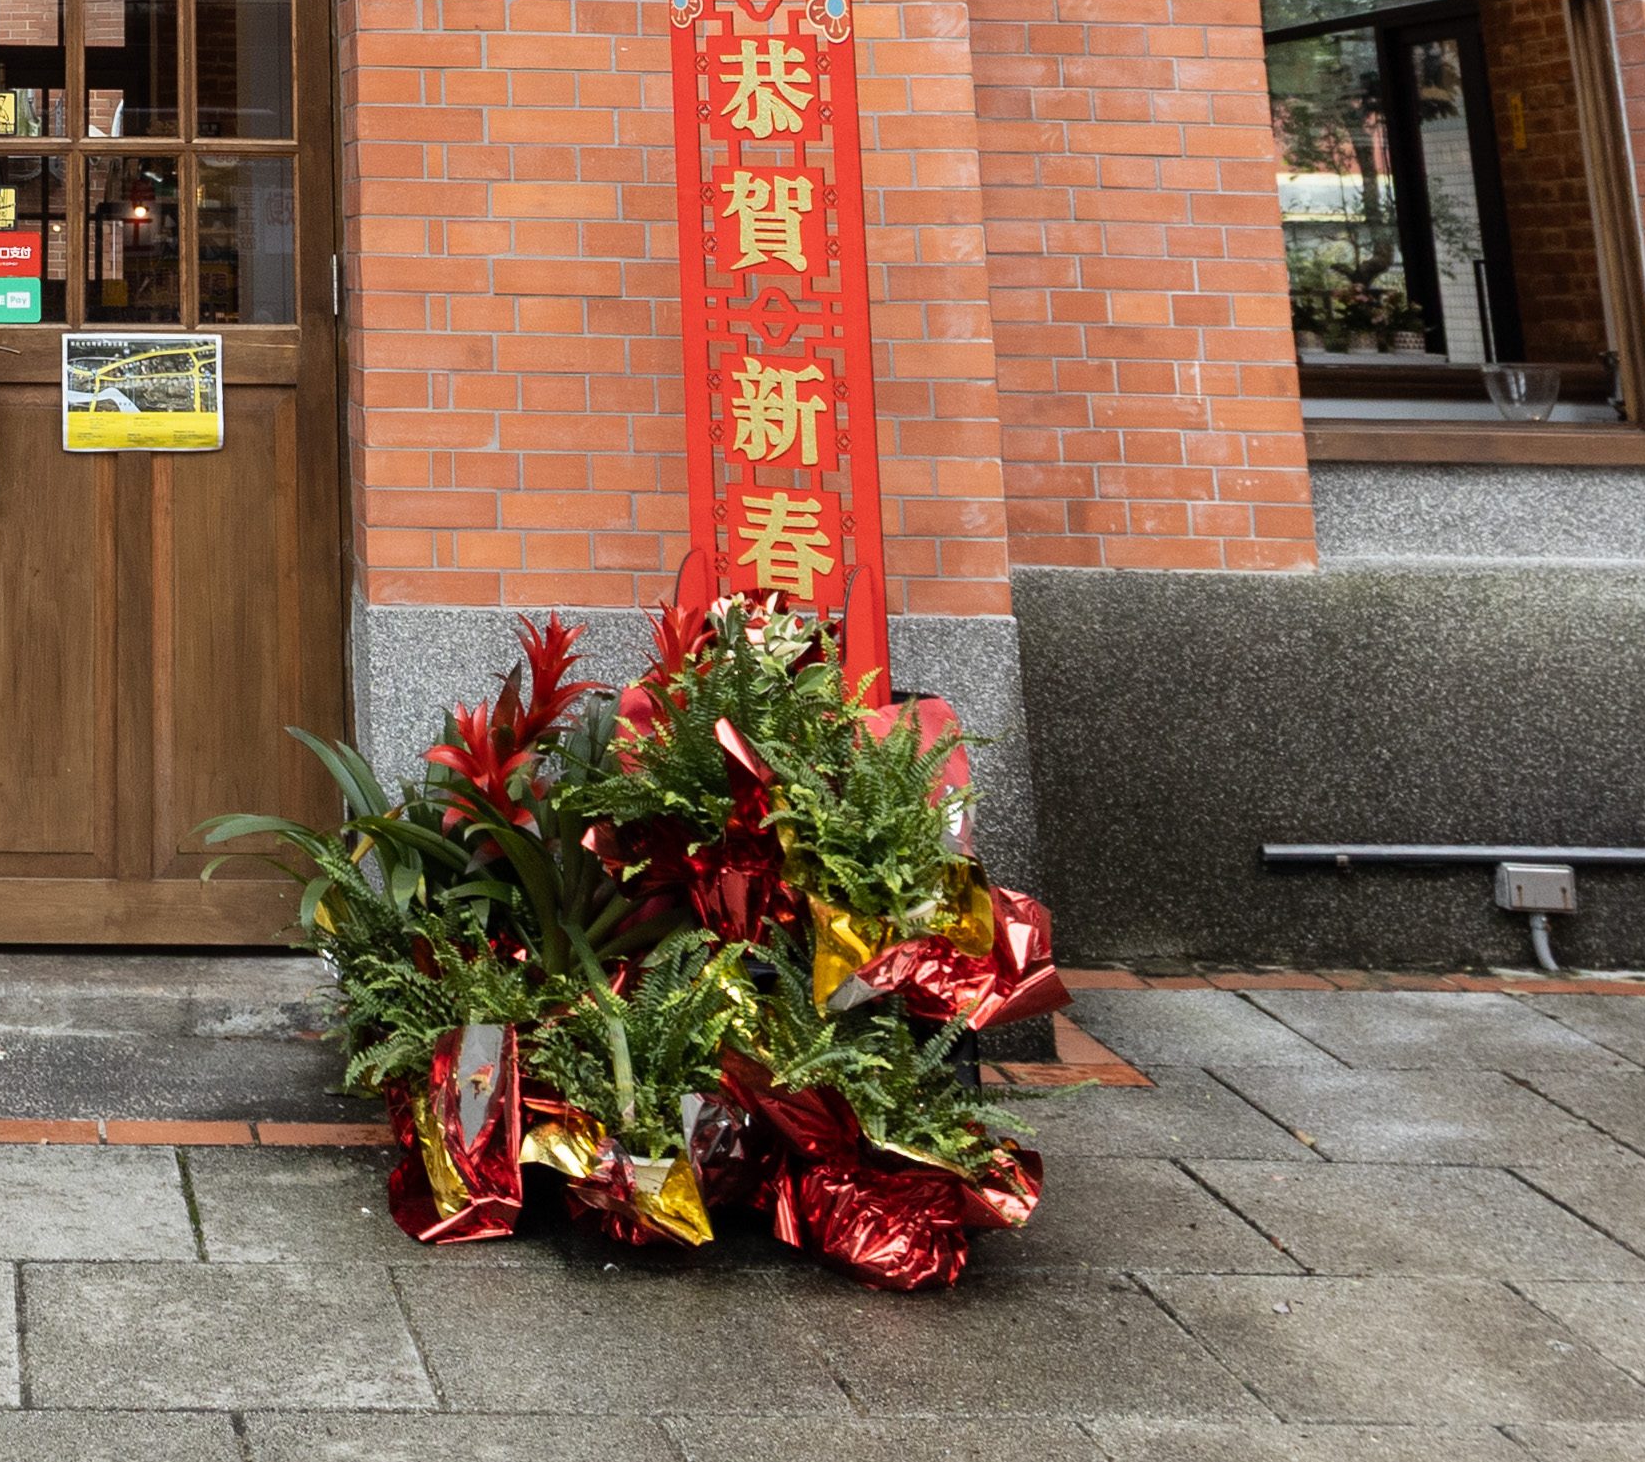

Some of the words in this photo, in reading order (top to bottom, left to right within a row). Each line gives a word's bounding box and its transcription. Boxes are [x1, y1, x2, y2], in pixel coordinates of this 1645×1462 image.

[10, 295, 28, 305] Pay
[717, 38, 836, 603] 恭賀新春
